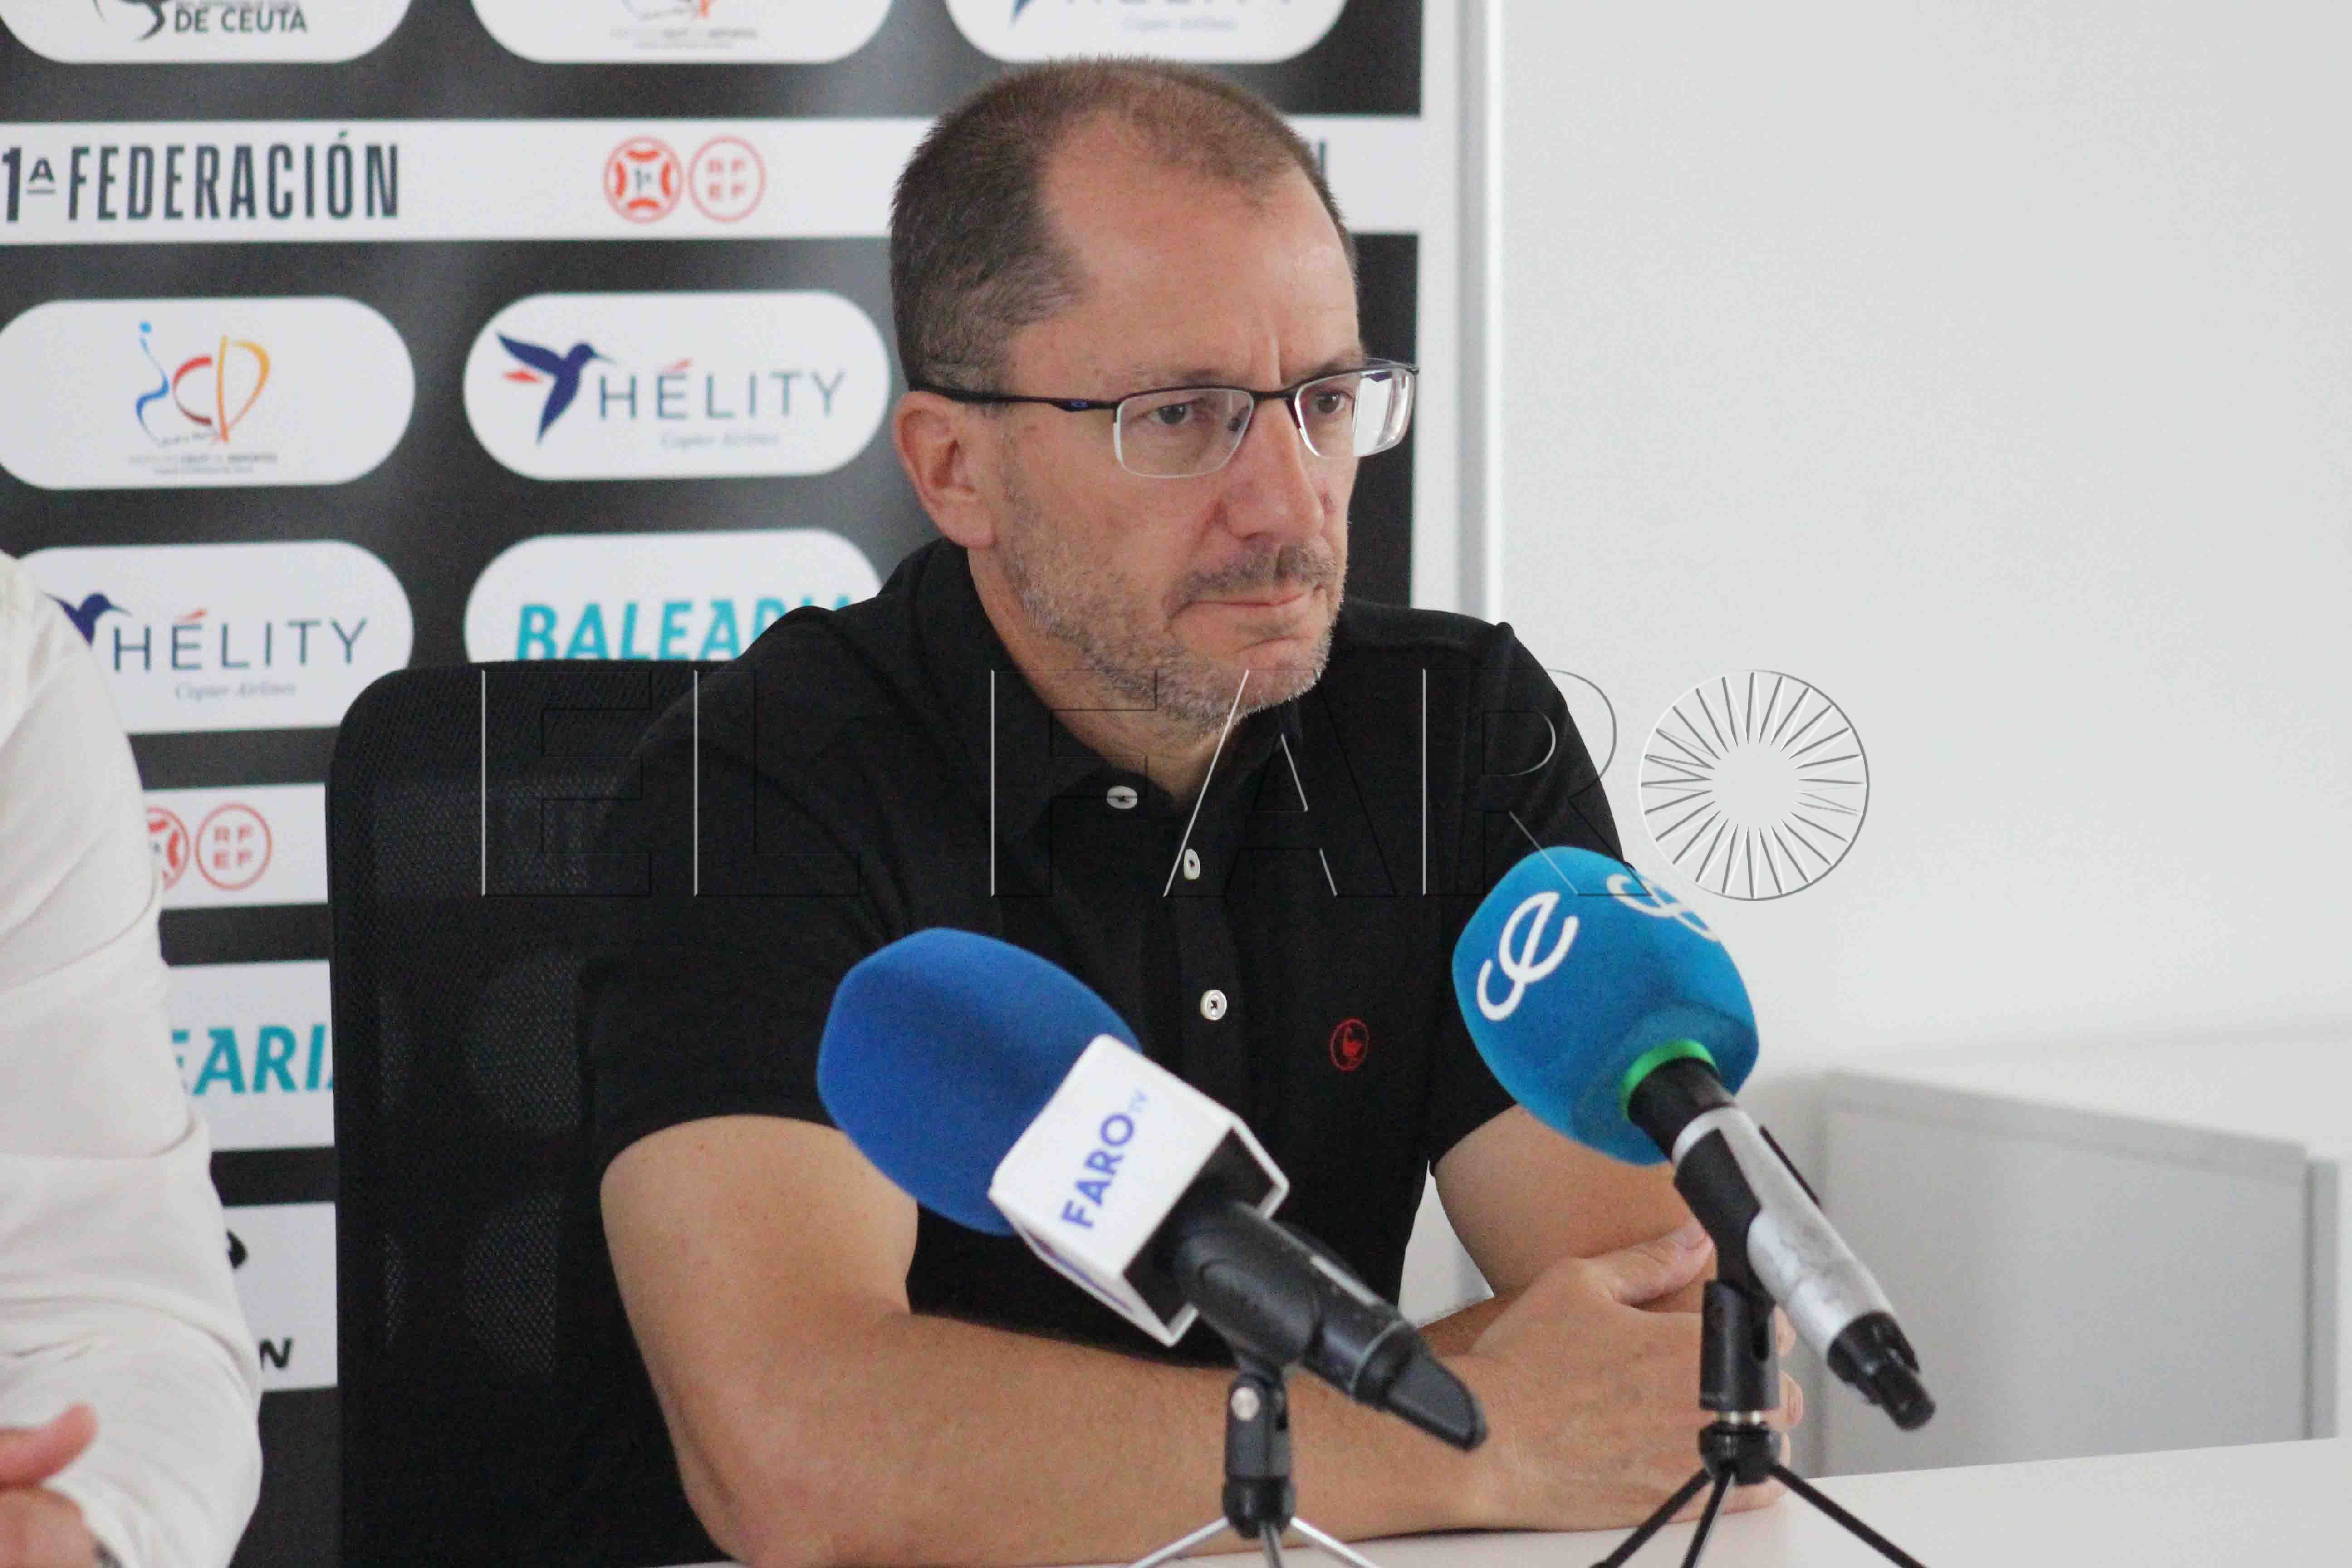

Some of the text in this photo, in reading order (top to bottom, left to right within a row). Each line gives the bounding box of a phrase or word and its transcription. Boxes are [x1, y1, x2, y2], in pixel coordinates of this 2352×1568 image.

[174, 6, 307, 33] DE CEUTA
[69, 131, 398, 220] FEDERACIÓN
[599, 358, 845, 420] HÉLITY
[113, 608, 367, 672] HÉLITY
[515, 595, 851, 661] BALEA
[172, 1024, 334, 1096] ARI
[1060, 1113, 1134, 1229] FARO
